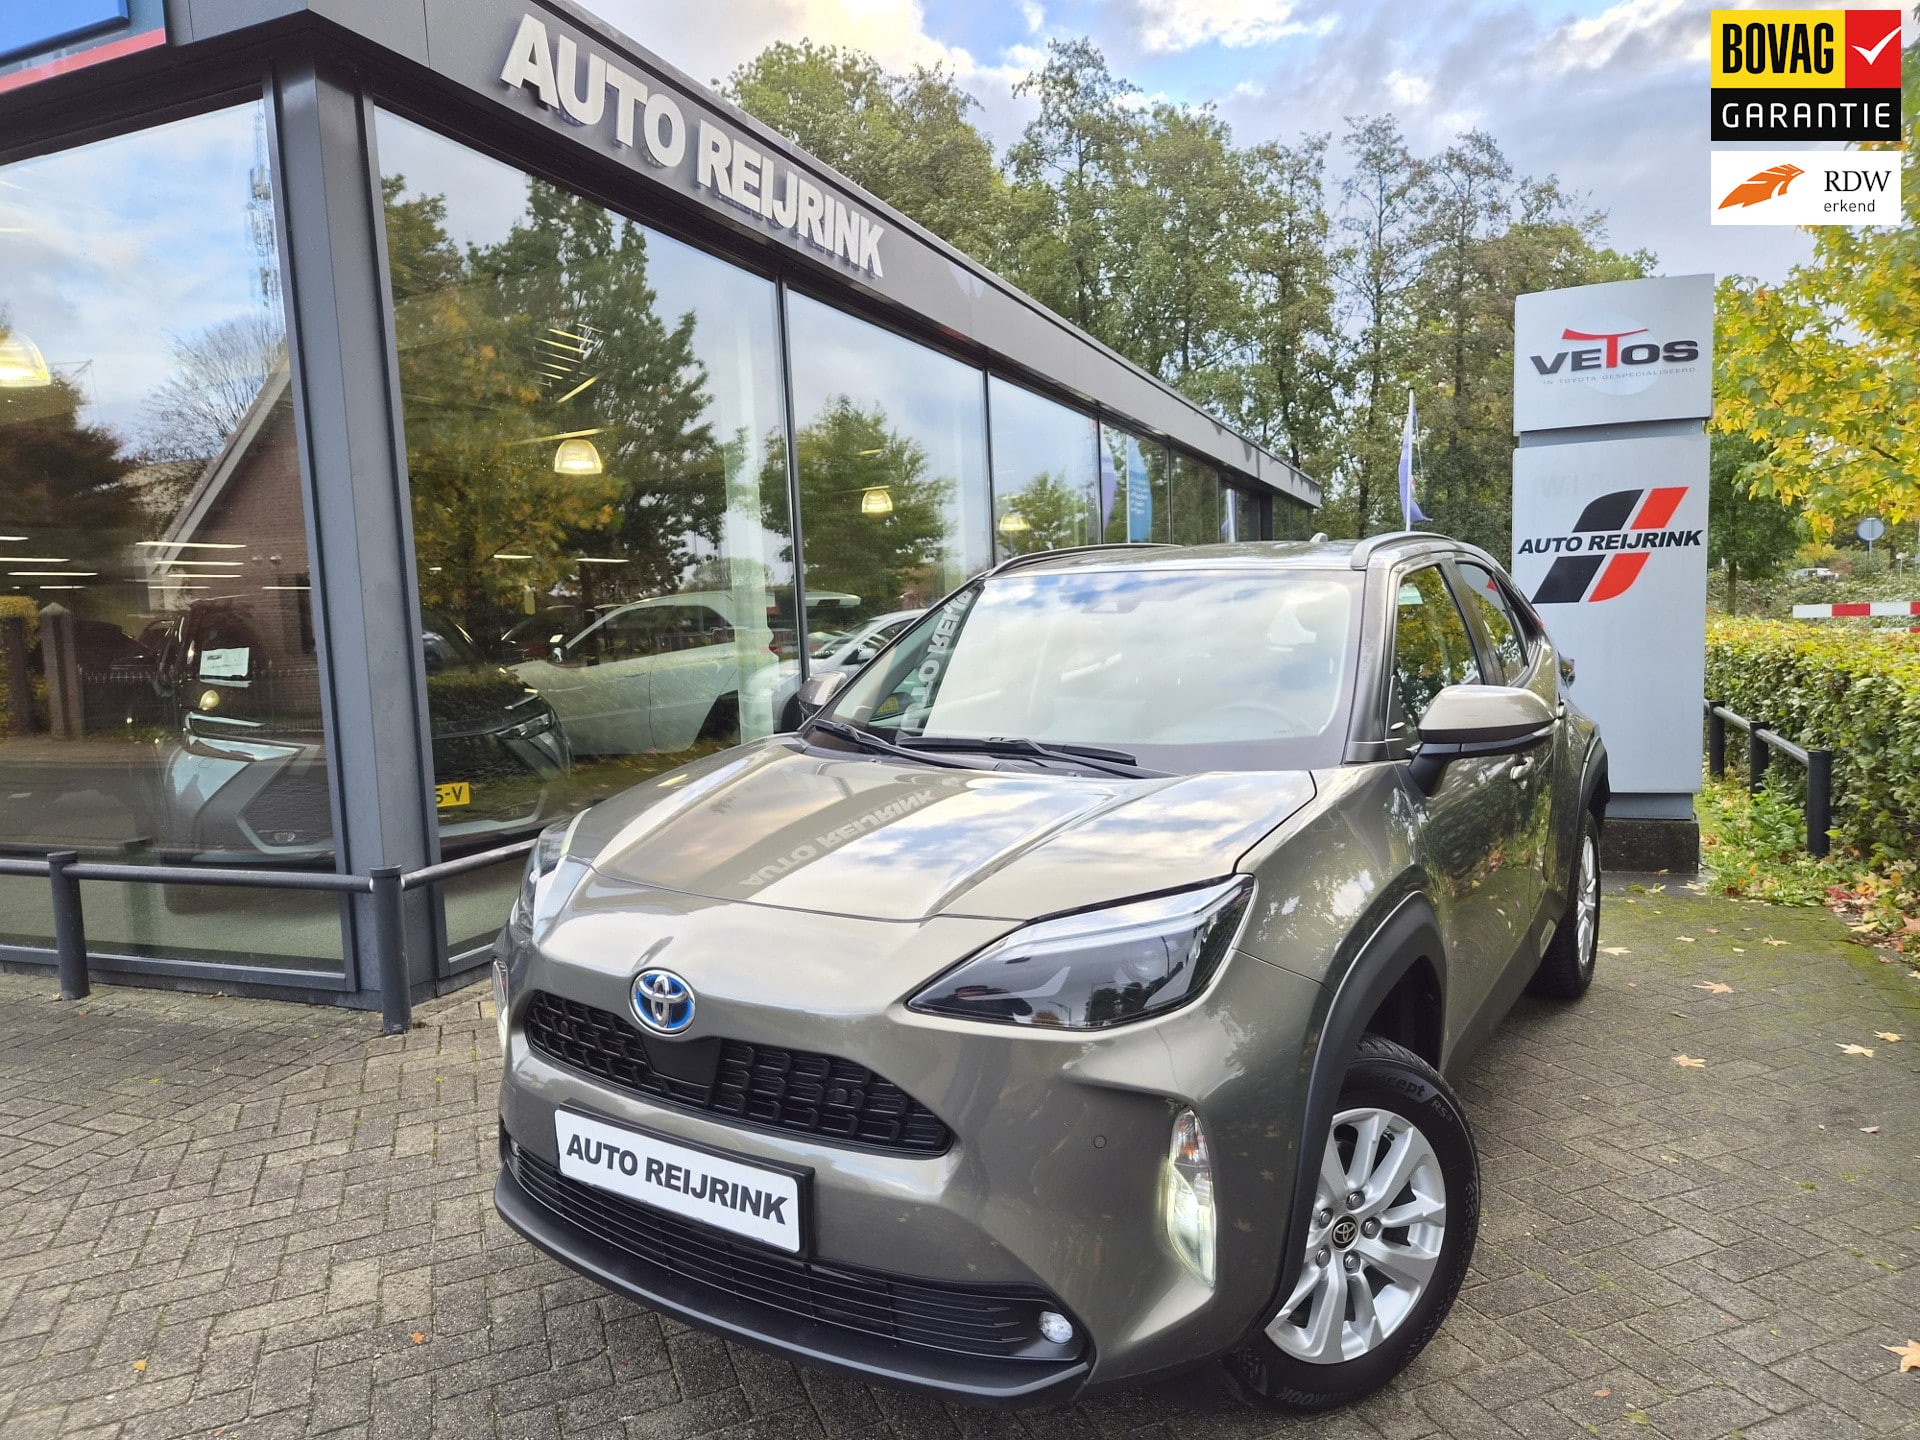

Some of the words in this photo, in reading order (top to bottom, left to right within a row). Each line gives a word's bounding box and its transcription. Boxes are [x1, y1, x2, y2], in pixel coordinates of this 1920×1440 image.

[501, 14, 686, 168] AUTO
[697, 120, 883, 278] REIJRINK
[1530, 328, 1699, 375] VETOS
[1559, 375, 1597, 384] TOYOTA
[1601, 367, 1696, 380] GESPECIALISEERD
[1518, 536, 1582, 554] AUTO
[1588, 530, 1703, 550] REIJRINK
[566, 1134, 638, 1176] AUTO
[645, 1157, 789, 1225] REIJRINK
